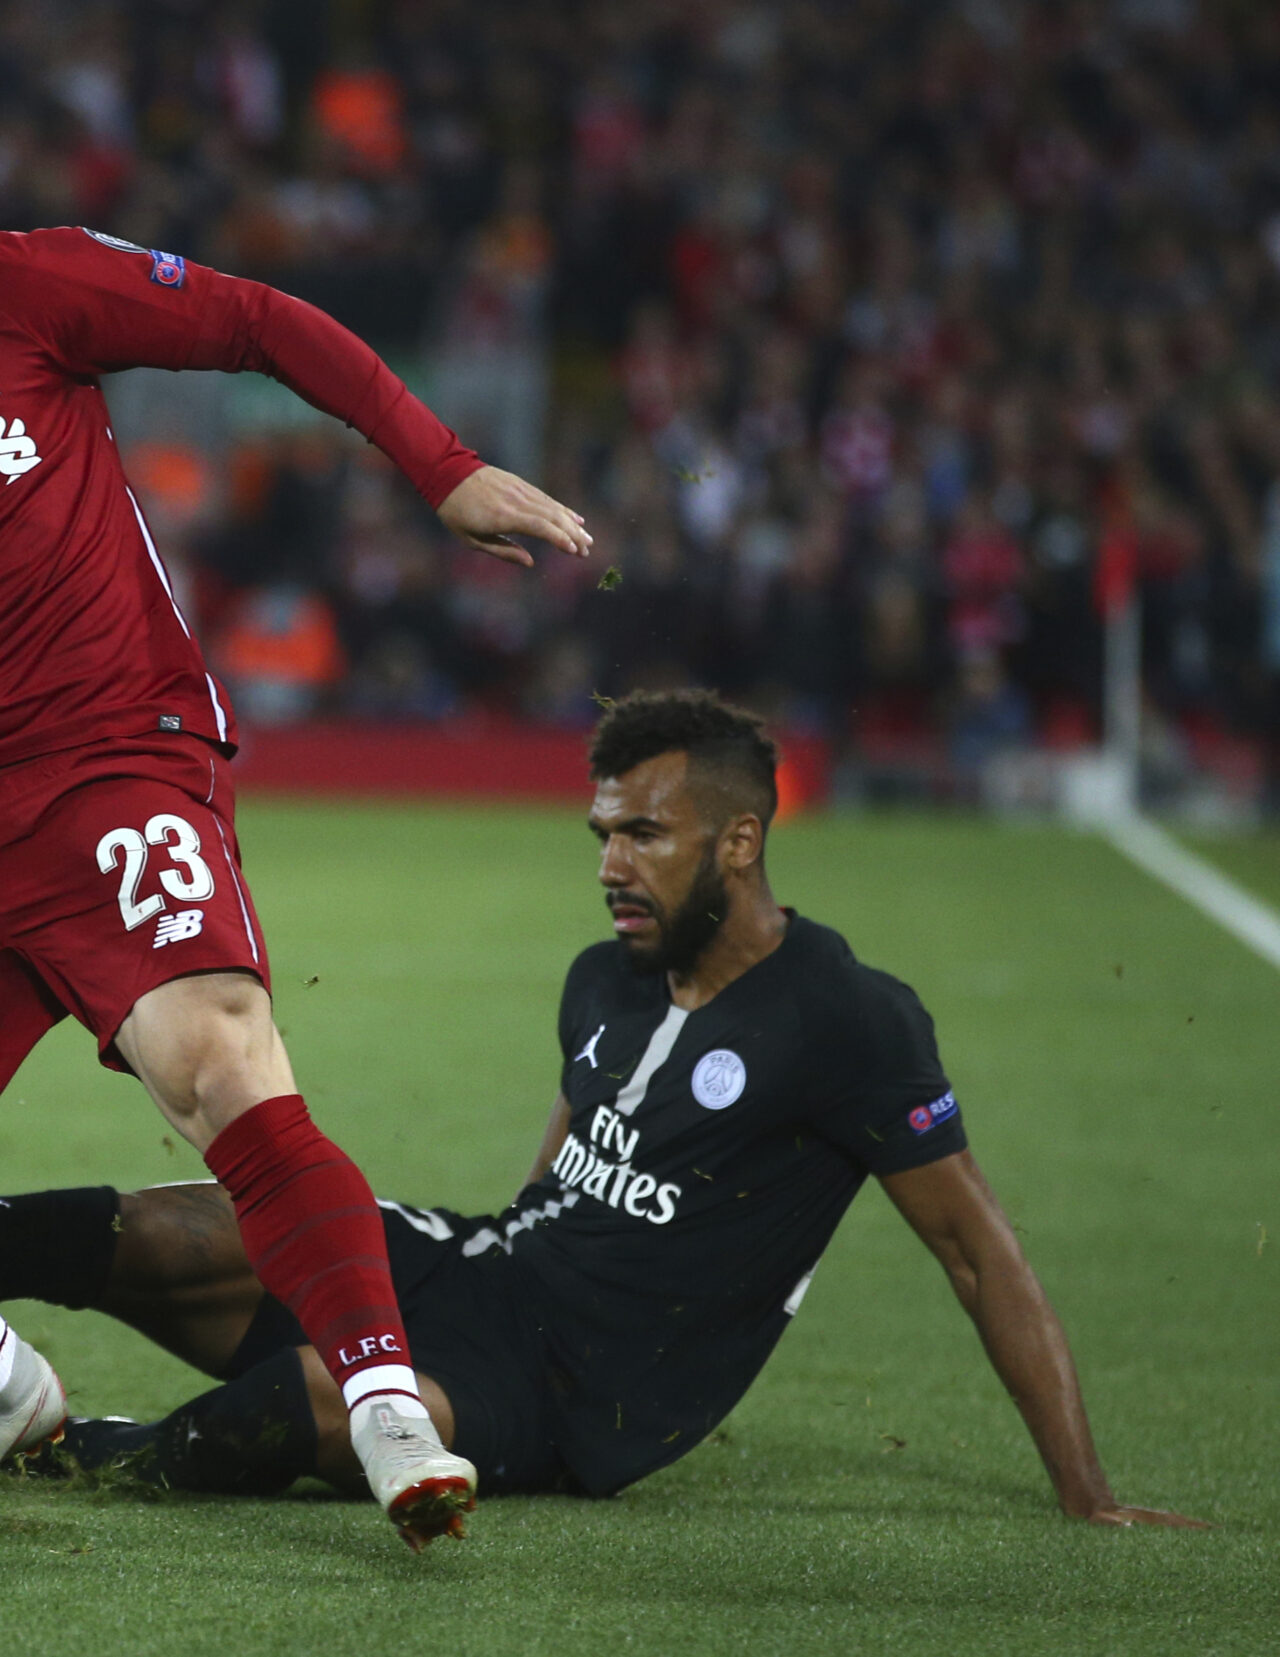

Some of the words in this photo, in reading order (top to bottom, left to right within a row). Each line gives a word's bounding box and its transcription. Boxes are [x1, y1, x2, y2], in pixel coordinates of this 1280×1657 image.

[96, 813, 215, 931] 23
[551, 1133, 681, 1225] mirates
[590, 1105, 639, 1162] Fly
